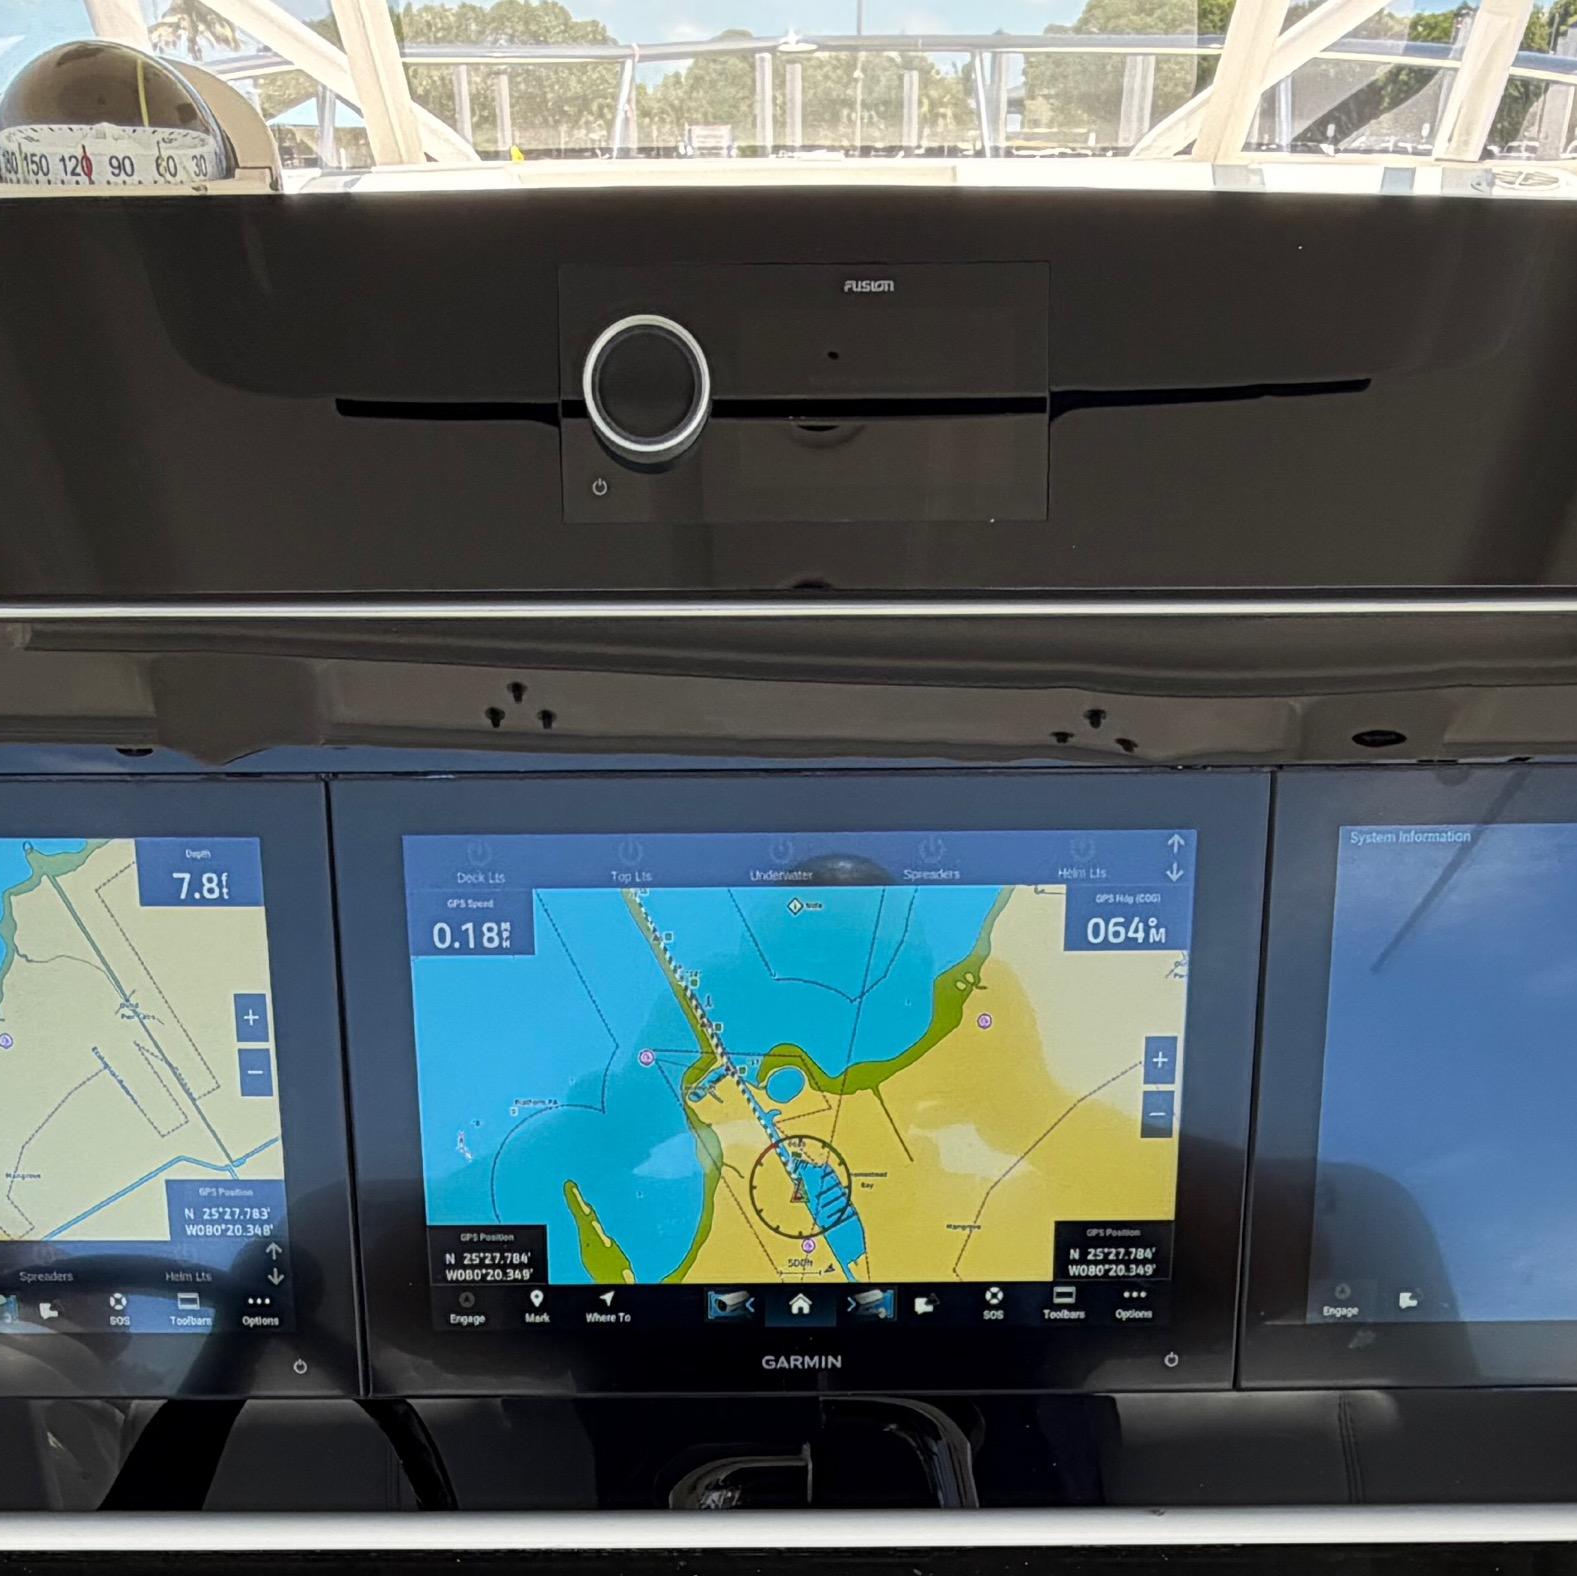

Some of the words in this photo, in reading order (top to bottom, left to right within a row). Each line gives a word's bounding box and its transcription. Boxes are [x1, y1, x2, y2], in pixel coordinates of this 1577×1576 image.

[24, 154, 50, 177] 150
[59, 156, 93, 177] 120
[109, 156, 135, 177] 90
[155, 155, 178, 177] 60
[192, 155, 208, 177] 30
[844, 280, 894, 292] FUSION
[1350, 831, 1396, 846] System
[1398, 830, 1472, 843] Information
[186, 849, 211, 860] Depth
[611, 871, 632, 884] Top
[750, 870, 813, 881] Underwater
[903, 869, 960, 881] Spreaders
[1058, 868, 1086, 879] Helm
[1095, 894, 1114, 903] GPS
[1116, 894, 1134, 904] Hdg
[1135, 893, 1161, 904] (COG)
[447, 899, 466, 909] GPS
[468, 899, 494, 910] Speed
[198, 1188, 217, 1197] GPS
[184, 1208, 195, 1221] N
[460, 1233, 478, 1242] GPS
[1086, 1228, 1105, 1237] GPS
[445, 1253, 456, 1264] N
[1069, 1248, 1080, 1260] N
[19, 1271, 74, 1283] Spreaders
[165, 1272, 193, 1282] Helm
[195, 1272, 213, 1282] Lts
[585, 1312, 617, 1323] Where
[618, 1312, 631, 1323] To
[983, 1310, 1004, 1320] SOS
[1043, 1309, 1086, 1319] Toolbars
[1115, 1309, 1153, 1321] Options
[1323, 1306, 1359, 1318] Engage
[109, 1316, 131, 1326] SOS
[169, 1316, 213, 1326] Toolbars
[242, 1316, 280, 1328] Options
[450, 1314, 486, 1326] Engage
[525, 1313, 550, 1323] Mark
[761, 1355, 842, 1369] GARMIN
